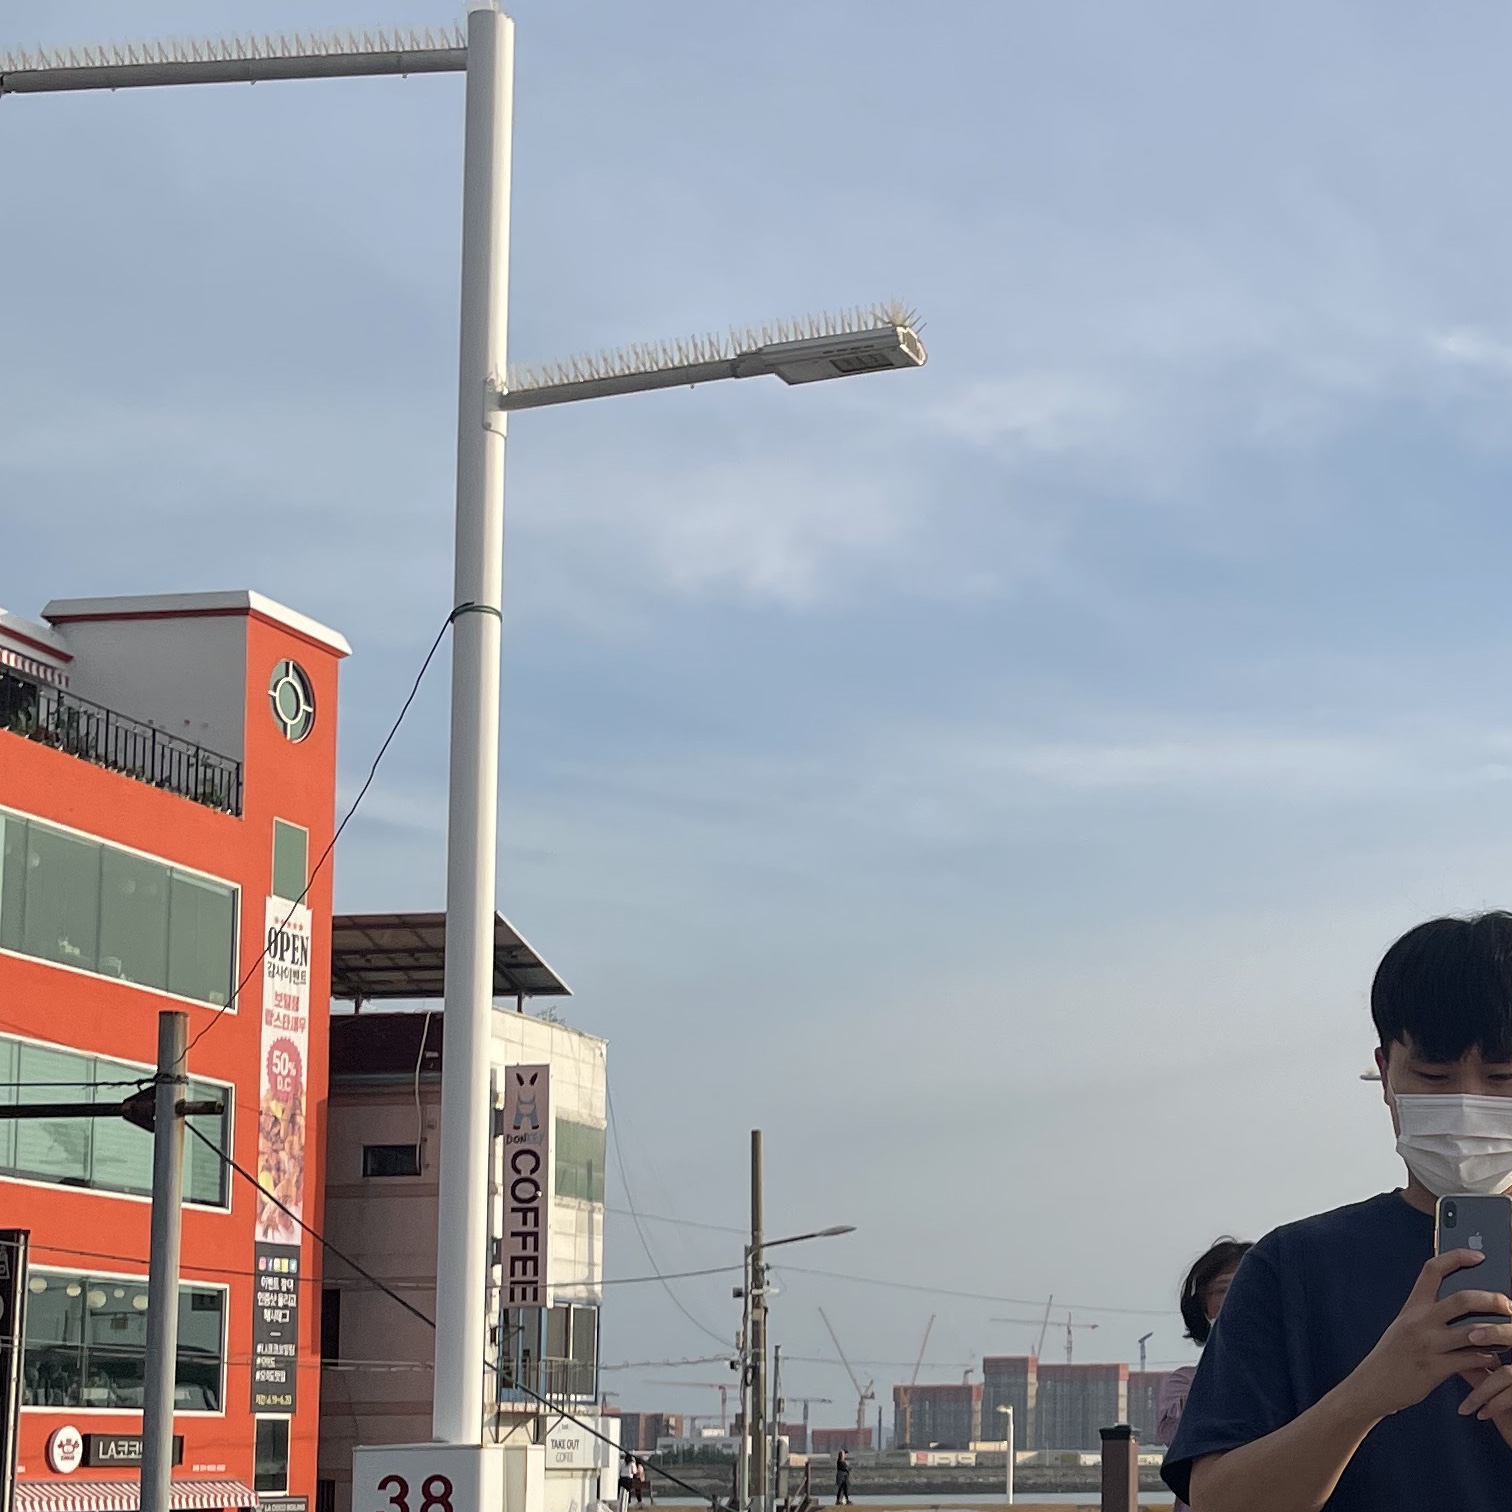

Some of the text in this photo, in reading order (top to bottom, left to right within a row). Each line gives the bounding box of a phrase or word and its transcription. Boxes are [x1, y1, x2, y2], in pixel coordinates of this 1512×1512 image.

[267, 926, 310, 968] OPEN
[267, 961, 307, 986] 감사이벤트
[272, 1050, 297, 1077] 50%
[510, 1149, 541, 1302] COFFEE
[263, 1308, 290, 1323] 해시태그
[551, 1438, 580, 1450] TAKE OUT
